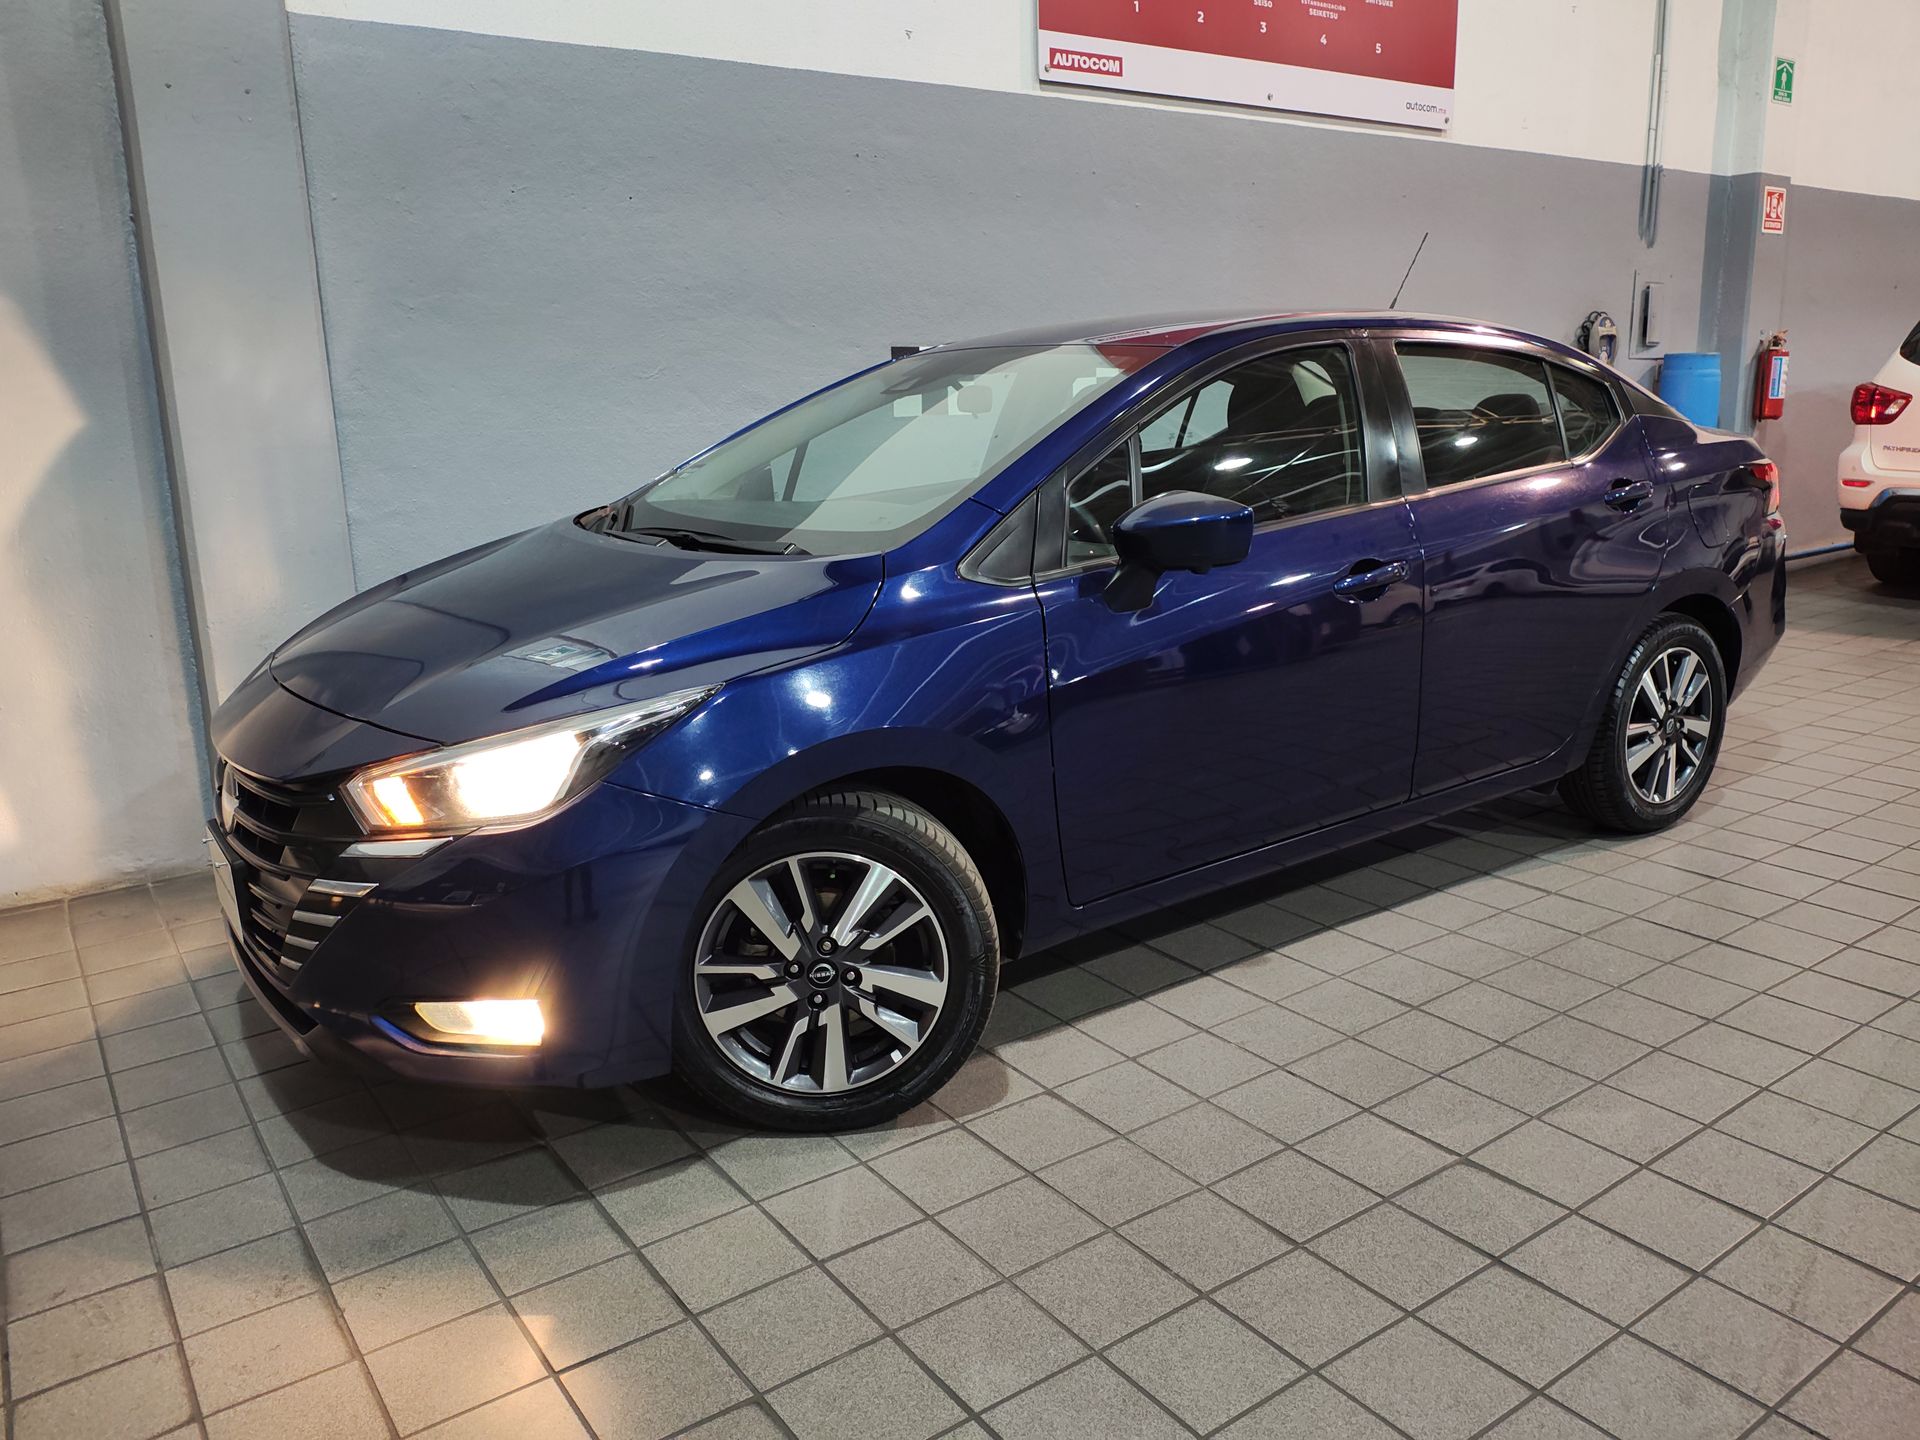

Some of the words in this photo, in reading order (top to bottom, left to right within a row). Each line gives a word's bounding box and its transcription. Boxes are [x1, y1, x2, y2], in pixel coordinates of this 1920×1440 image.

[1133, 0, 1140, 12] 1
[1197, 11, 1204, 23] 2
[1309, 8, 1338, 20] SEIKETSU
[1260, 21, 1267, 33] 3
[1320, 34, 1327, 45] 4
[1375, 43, 1382, 54] 5
[1053, 53, 1120, 73] AUTOCOM
